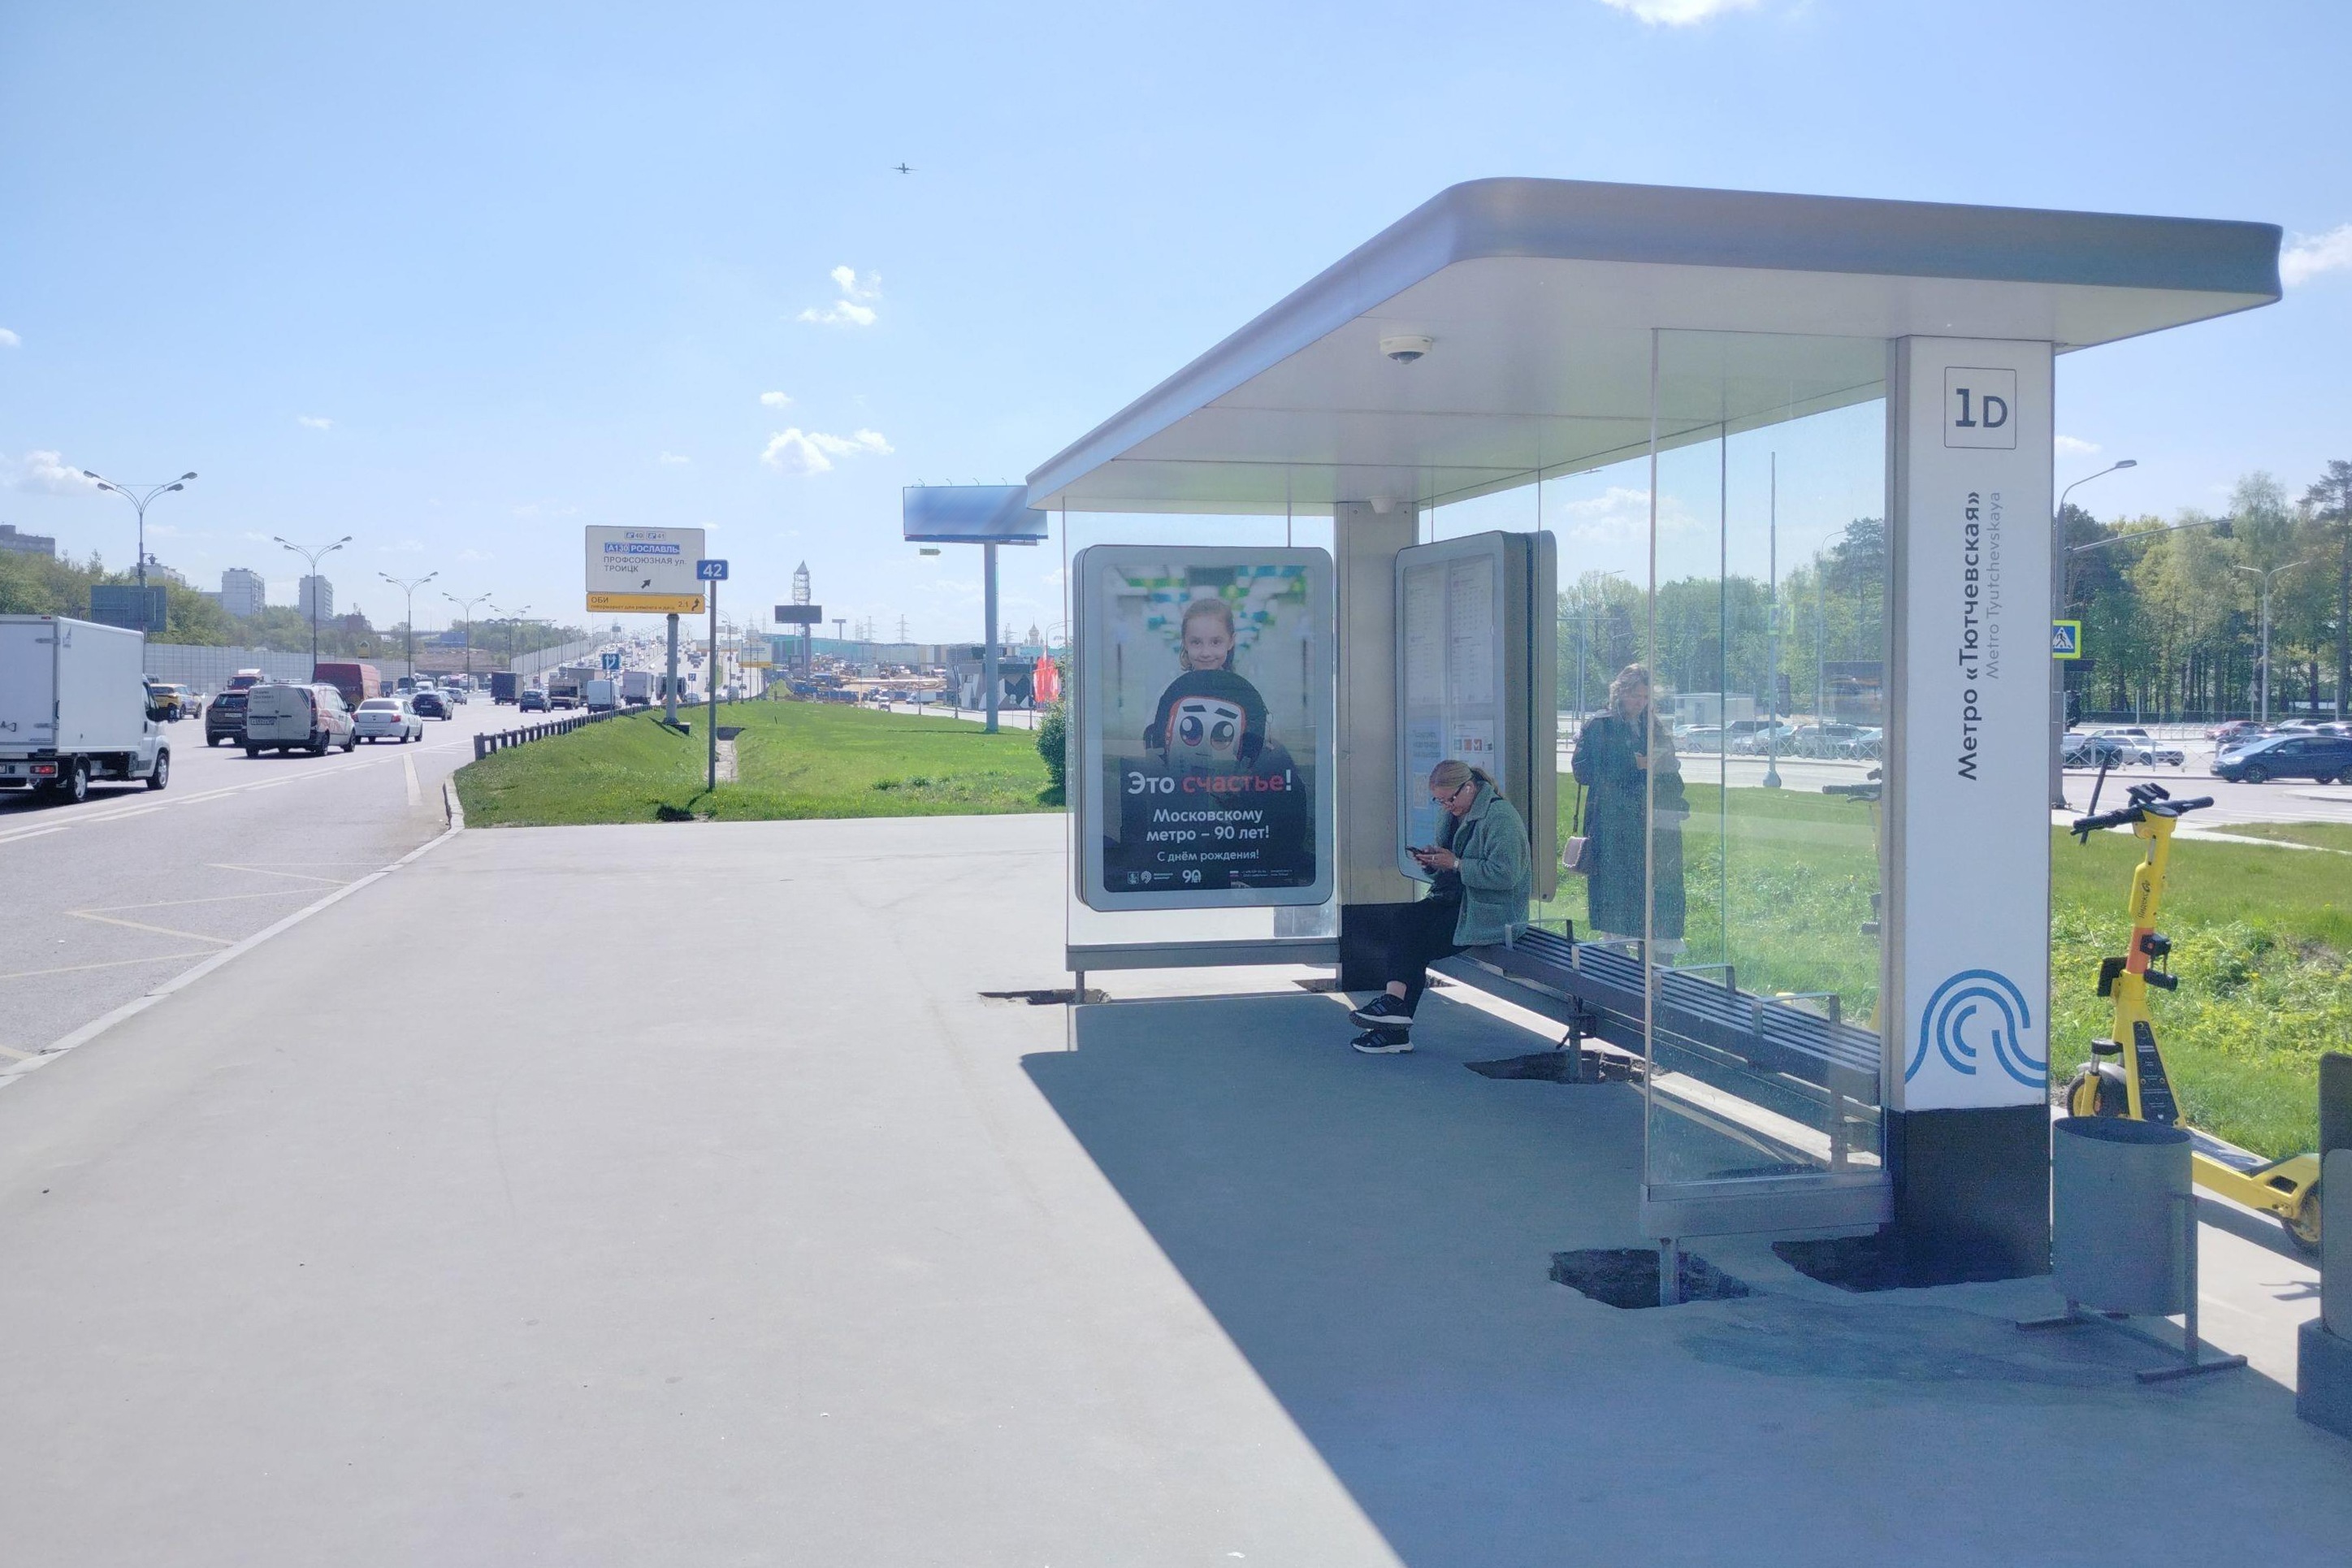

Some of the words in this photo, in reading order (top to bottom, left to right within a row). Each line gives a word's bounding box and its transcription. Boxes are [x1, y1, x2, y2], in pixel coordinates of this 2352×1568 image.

[1955, 388, 2008, 428] 1D
[604, 557, 673, 565] ПРОФСОЮЗНАЯ
[1986, 492, 2004, 619] Tyutchevskaya
[604, 565, 639, 574] ТРОИЦК
[703, 563, 723, 578] 42
[1959, 492, 1981, 681] «Тютчевская»
[1986, 624, 2000, 679] Metro
[1958, 689, 1982, 782] Метро
[1127, 771, 1176, 795] Это
[1182, 769, 1293, 793] счастье!
[1152, 808, 1263, 823] Московскому
[1146, 829, 1197, 844] метро
[1214, 825, 1235, 840] 90
[1238, 825, 1270, 839] лет!
[1157, 851, 1166, 862] С
[1167, 851, 1198, 863] днём
[1200, 849, 1259, 863] рождения!
